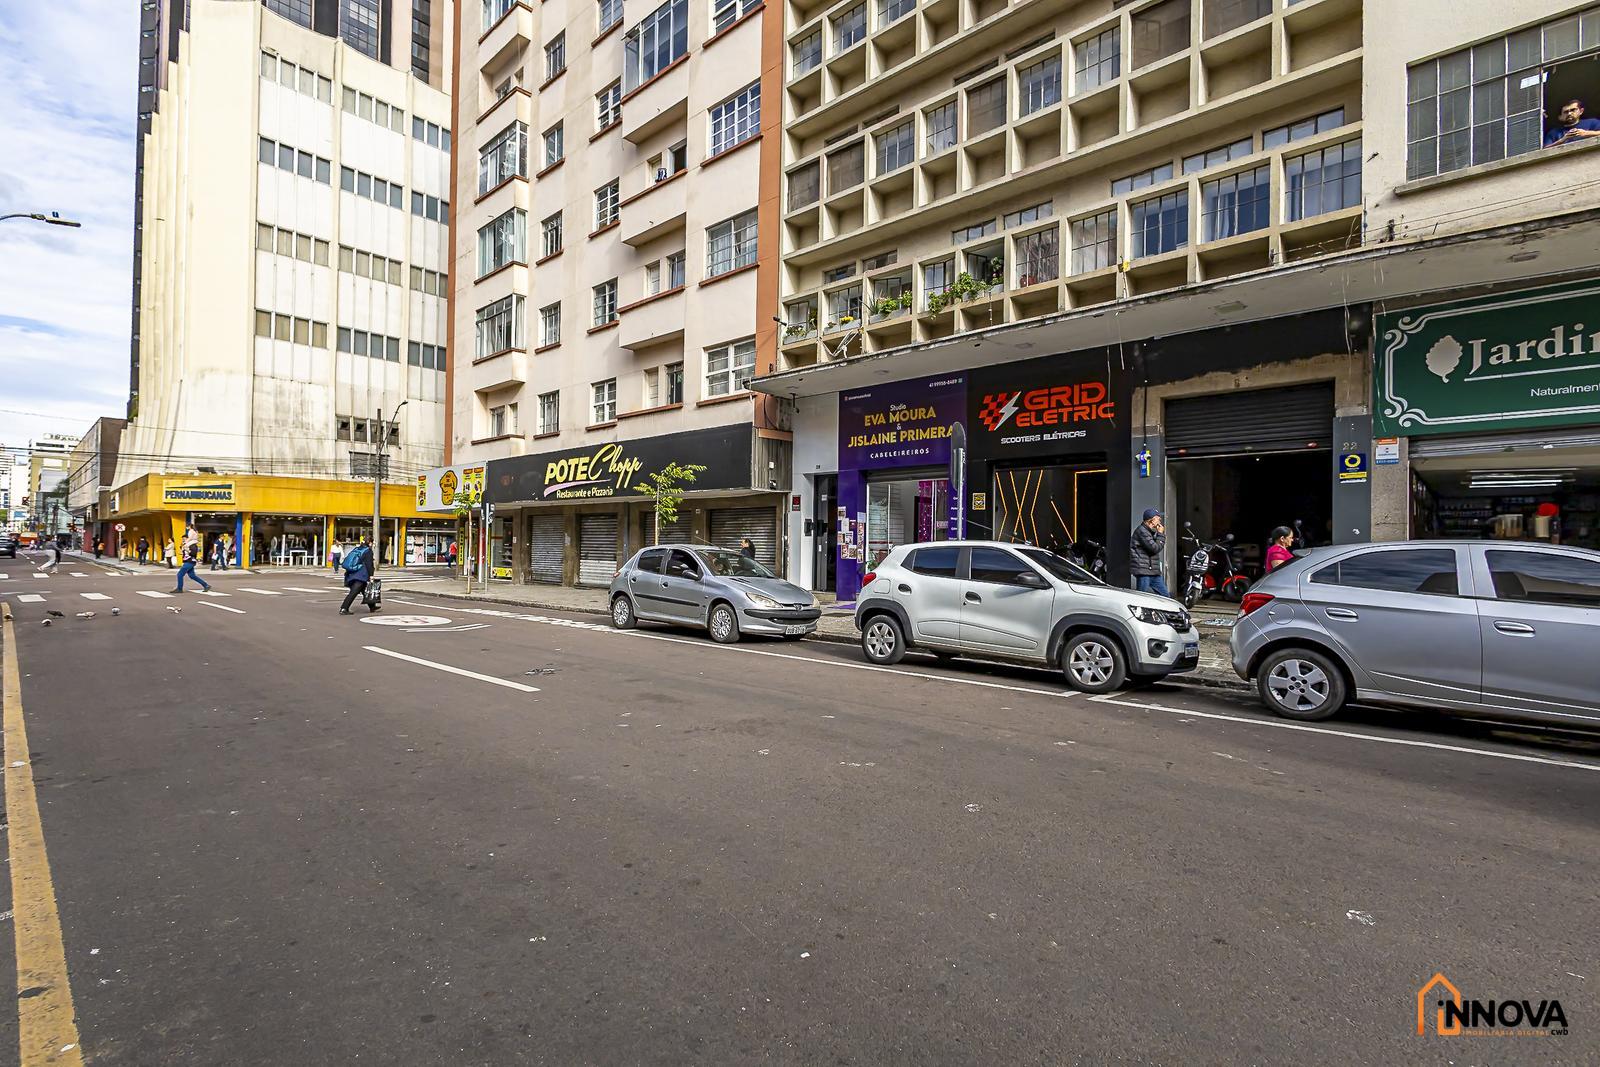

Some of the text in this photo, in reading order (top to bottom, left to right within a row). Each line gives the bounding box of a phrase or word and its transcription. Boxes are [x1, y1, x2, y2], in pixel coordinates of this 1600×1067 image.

[1024, 382, 1106, 411] GRID
[1530, 383, 1600, 397] Naturalmen
[890, 403, 907, 412] Studio
[864, 406, 937, 427] EVA MOURA
[1015, 402, 1115, 428] ELETRIC
[896, 423, 902, 431] &
[847, 431, 897, 448] JISLAINE
[1000, 430, 1087, 445] SCOOTERS ELÉTRICAS
[870, 447, 930, 459] CABELEIREIROS
[1342, 441, 1358, 451] 22
[544, 443, 643, 489] POTE Chopp
[165, 490, 232, 501] PERNAMBUCANAS
[556, 488, 587, 499] Restaurante
[591, 486, 614, 497] Pizzaria
